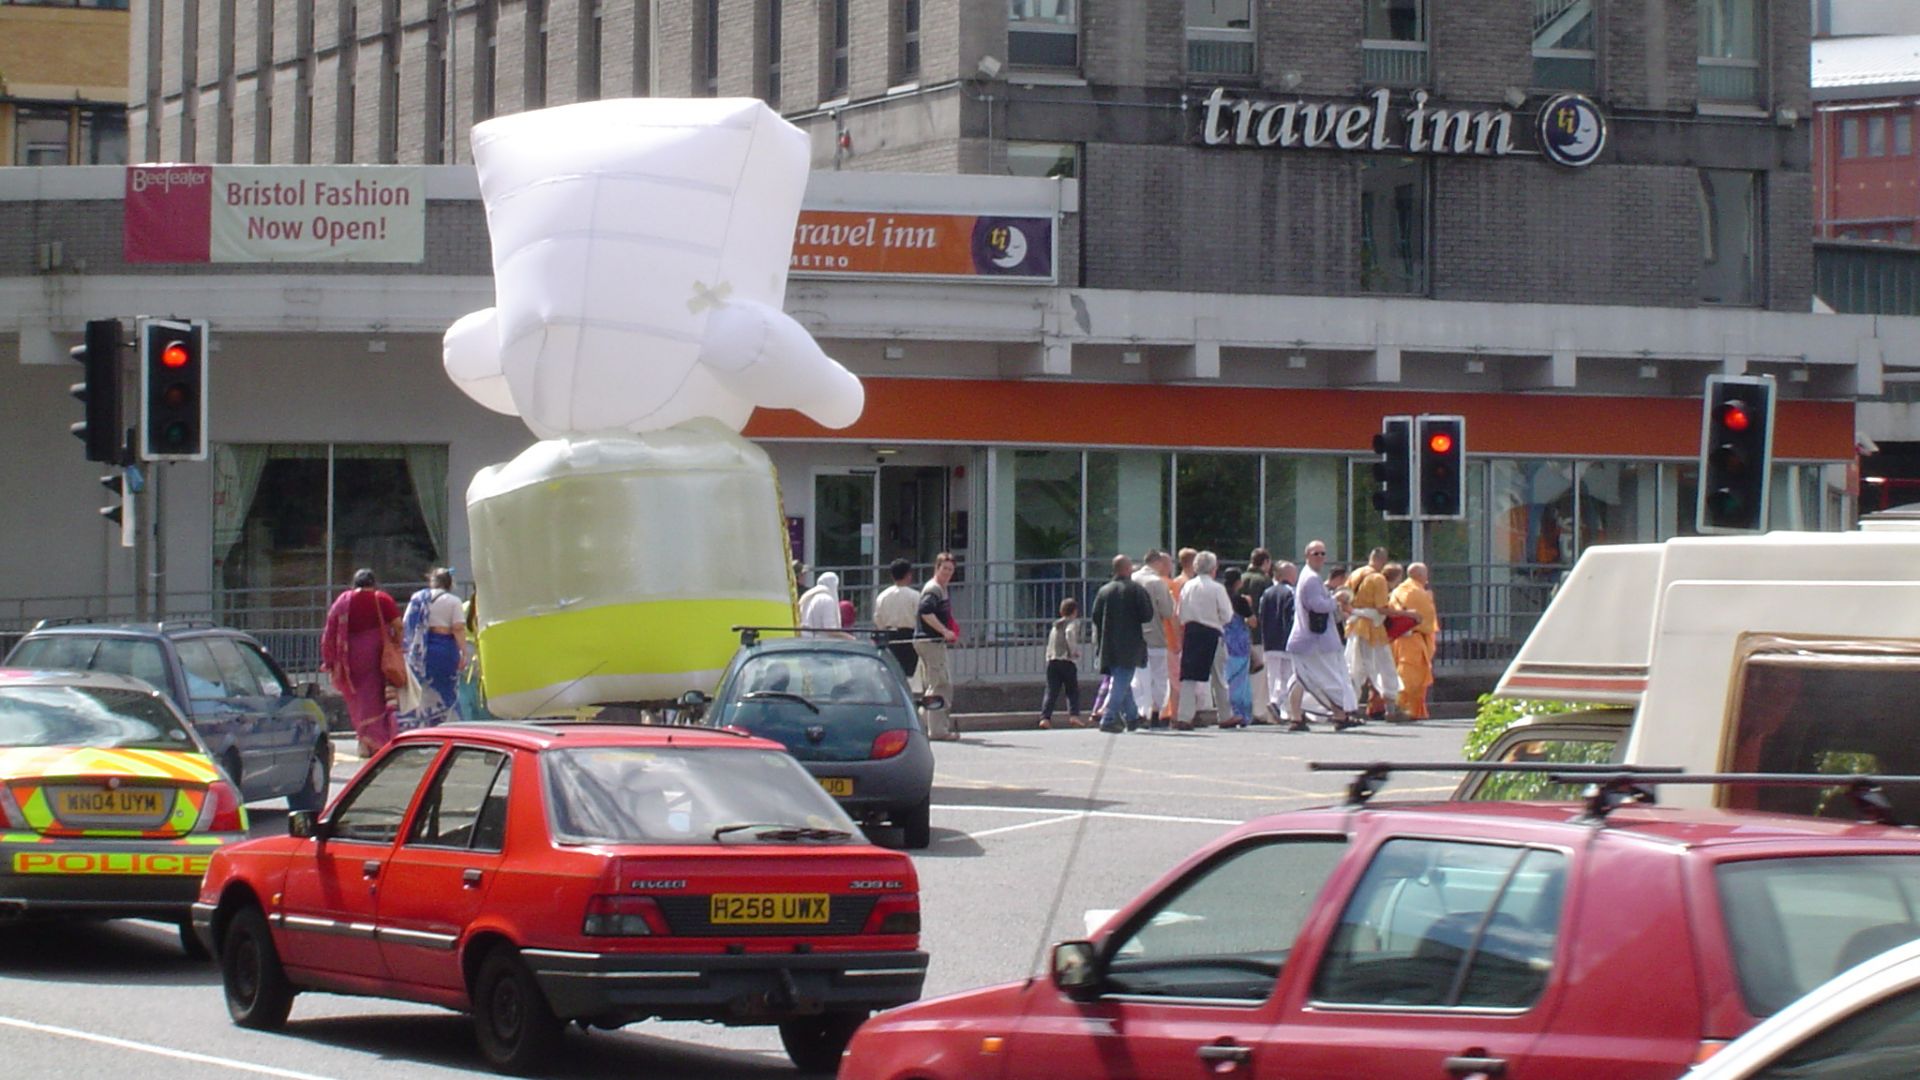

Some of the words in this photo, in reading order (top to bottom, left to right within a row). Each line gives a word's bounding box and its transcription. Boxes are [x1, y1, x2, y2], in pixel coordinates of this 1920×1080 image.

[1202, 86, 1390, 151] travel
[1406, 89, 1515, 155] inn
[132, 168, 206, 194] Beefeater
[227, 179, 305, 206] Bristol
[315, 179, 410, 207] Fashion
[248, 216, 302, 240] Now
[312, 216, 387, 247] Open!
[794, 217, 876, 248] ravel
[882, 218, 937, 249] inn
[19, 853, 208, 873] POLICE
[631, 879, 687, 889] PEUGEOT
[713, 897, 775, 919] H258
[782, 897, 827, 919] UWX
